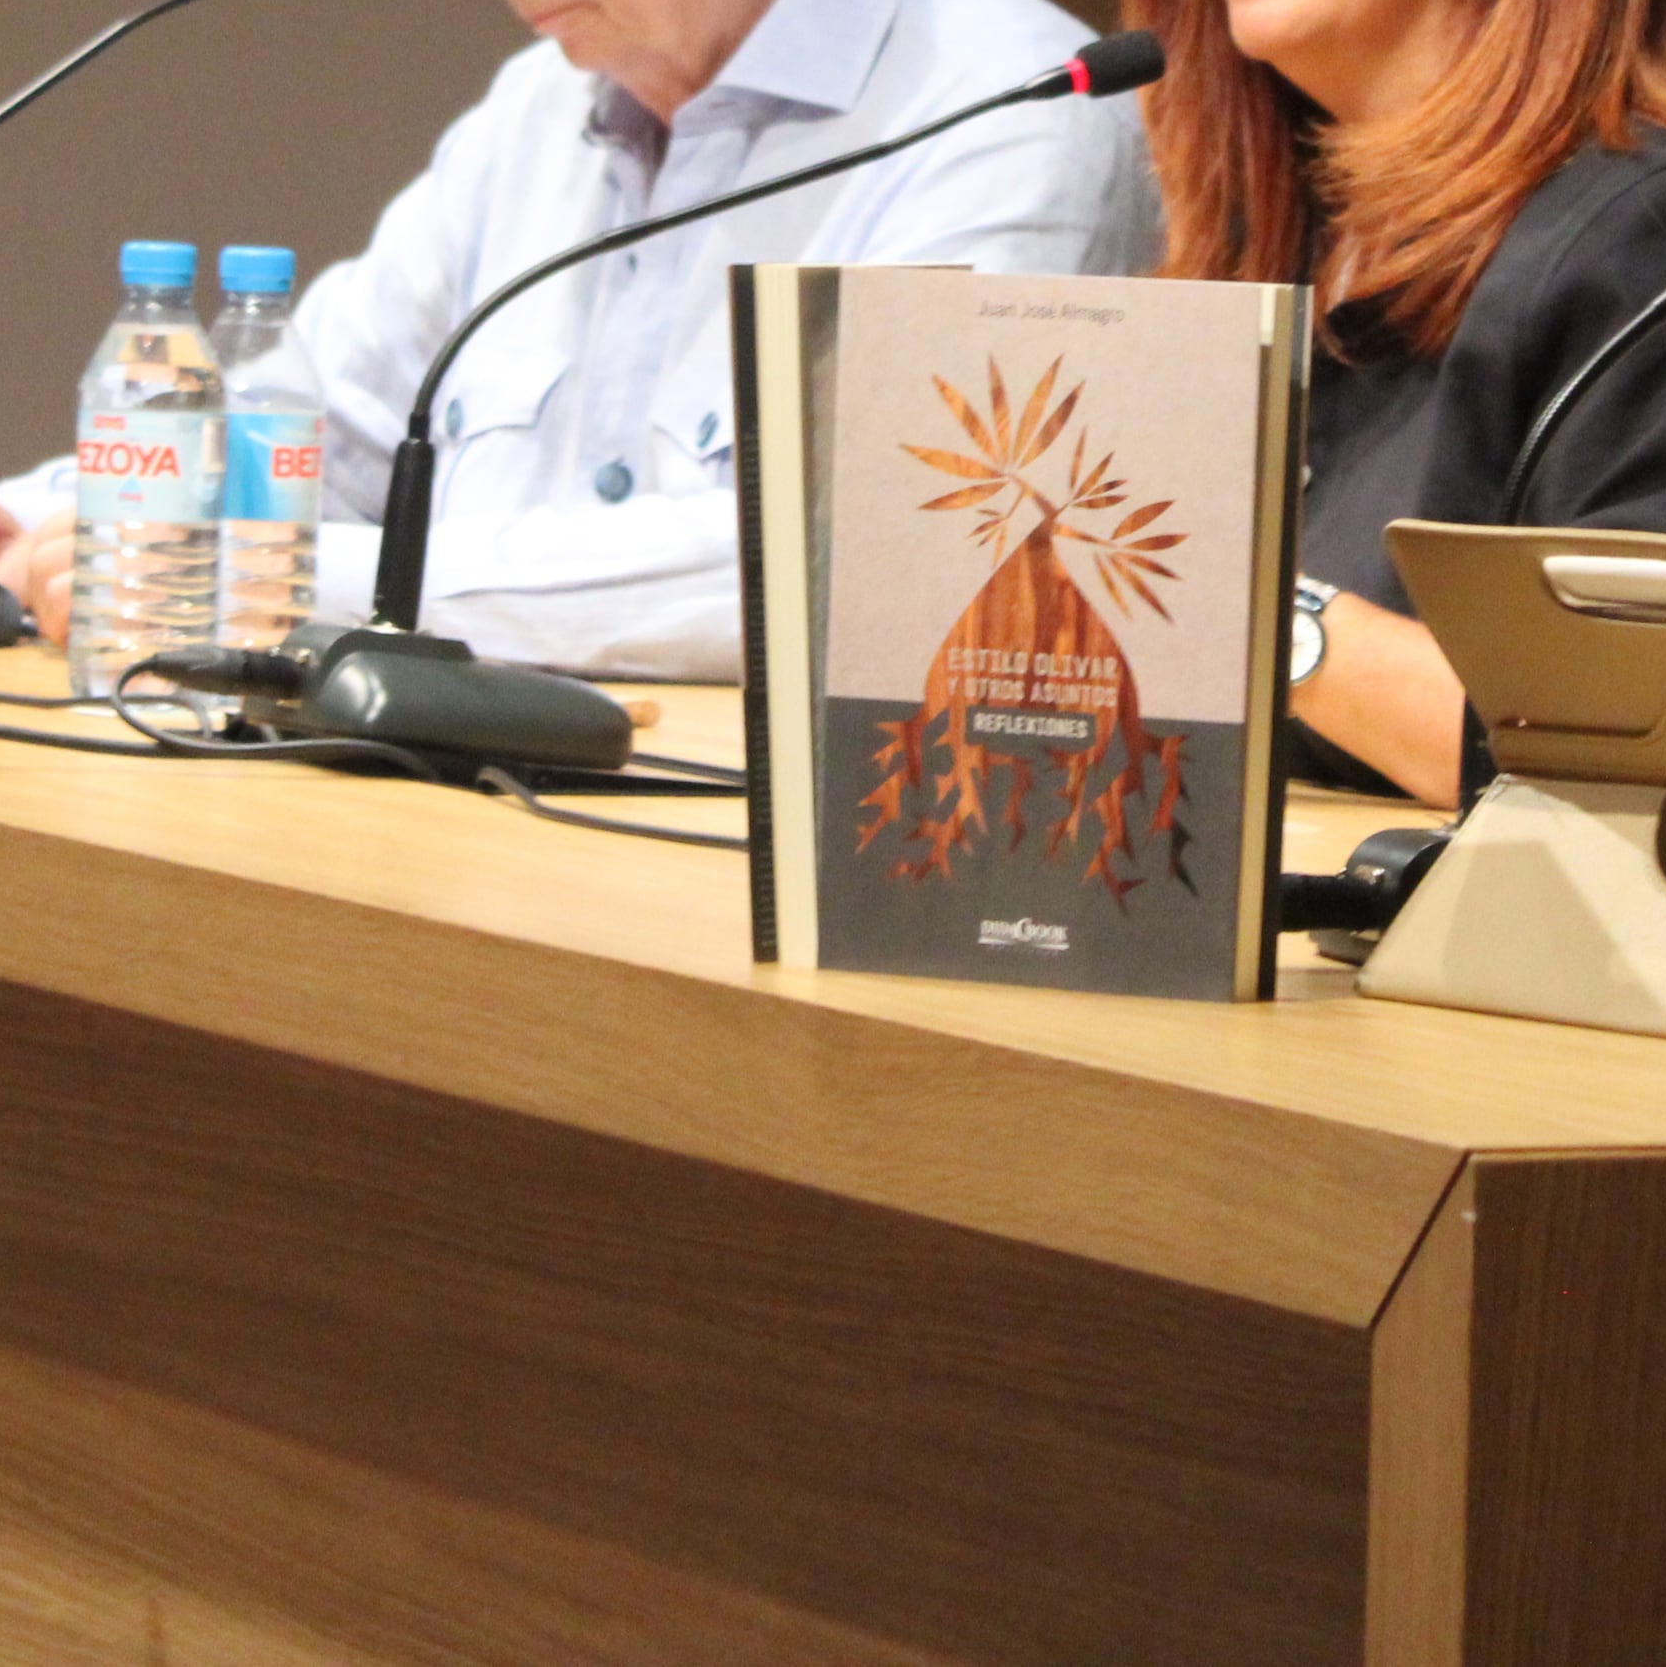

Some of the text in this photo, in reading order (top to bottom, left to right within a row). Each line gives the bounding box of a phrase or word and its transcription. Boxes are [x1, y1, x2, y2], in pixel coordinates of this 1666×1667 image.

[77, 441, 182, 478] EZOYA
[947, 647, 1119, 680] ESTILO OLIVAR
[947, 677, 1118, 708] Y OTROS ASUNTOS
[973, 712, 1089, 739] REFLEXIONES
